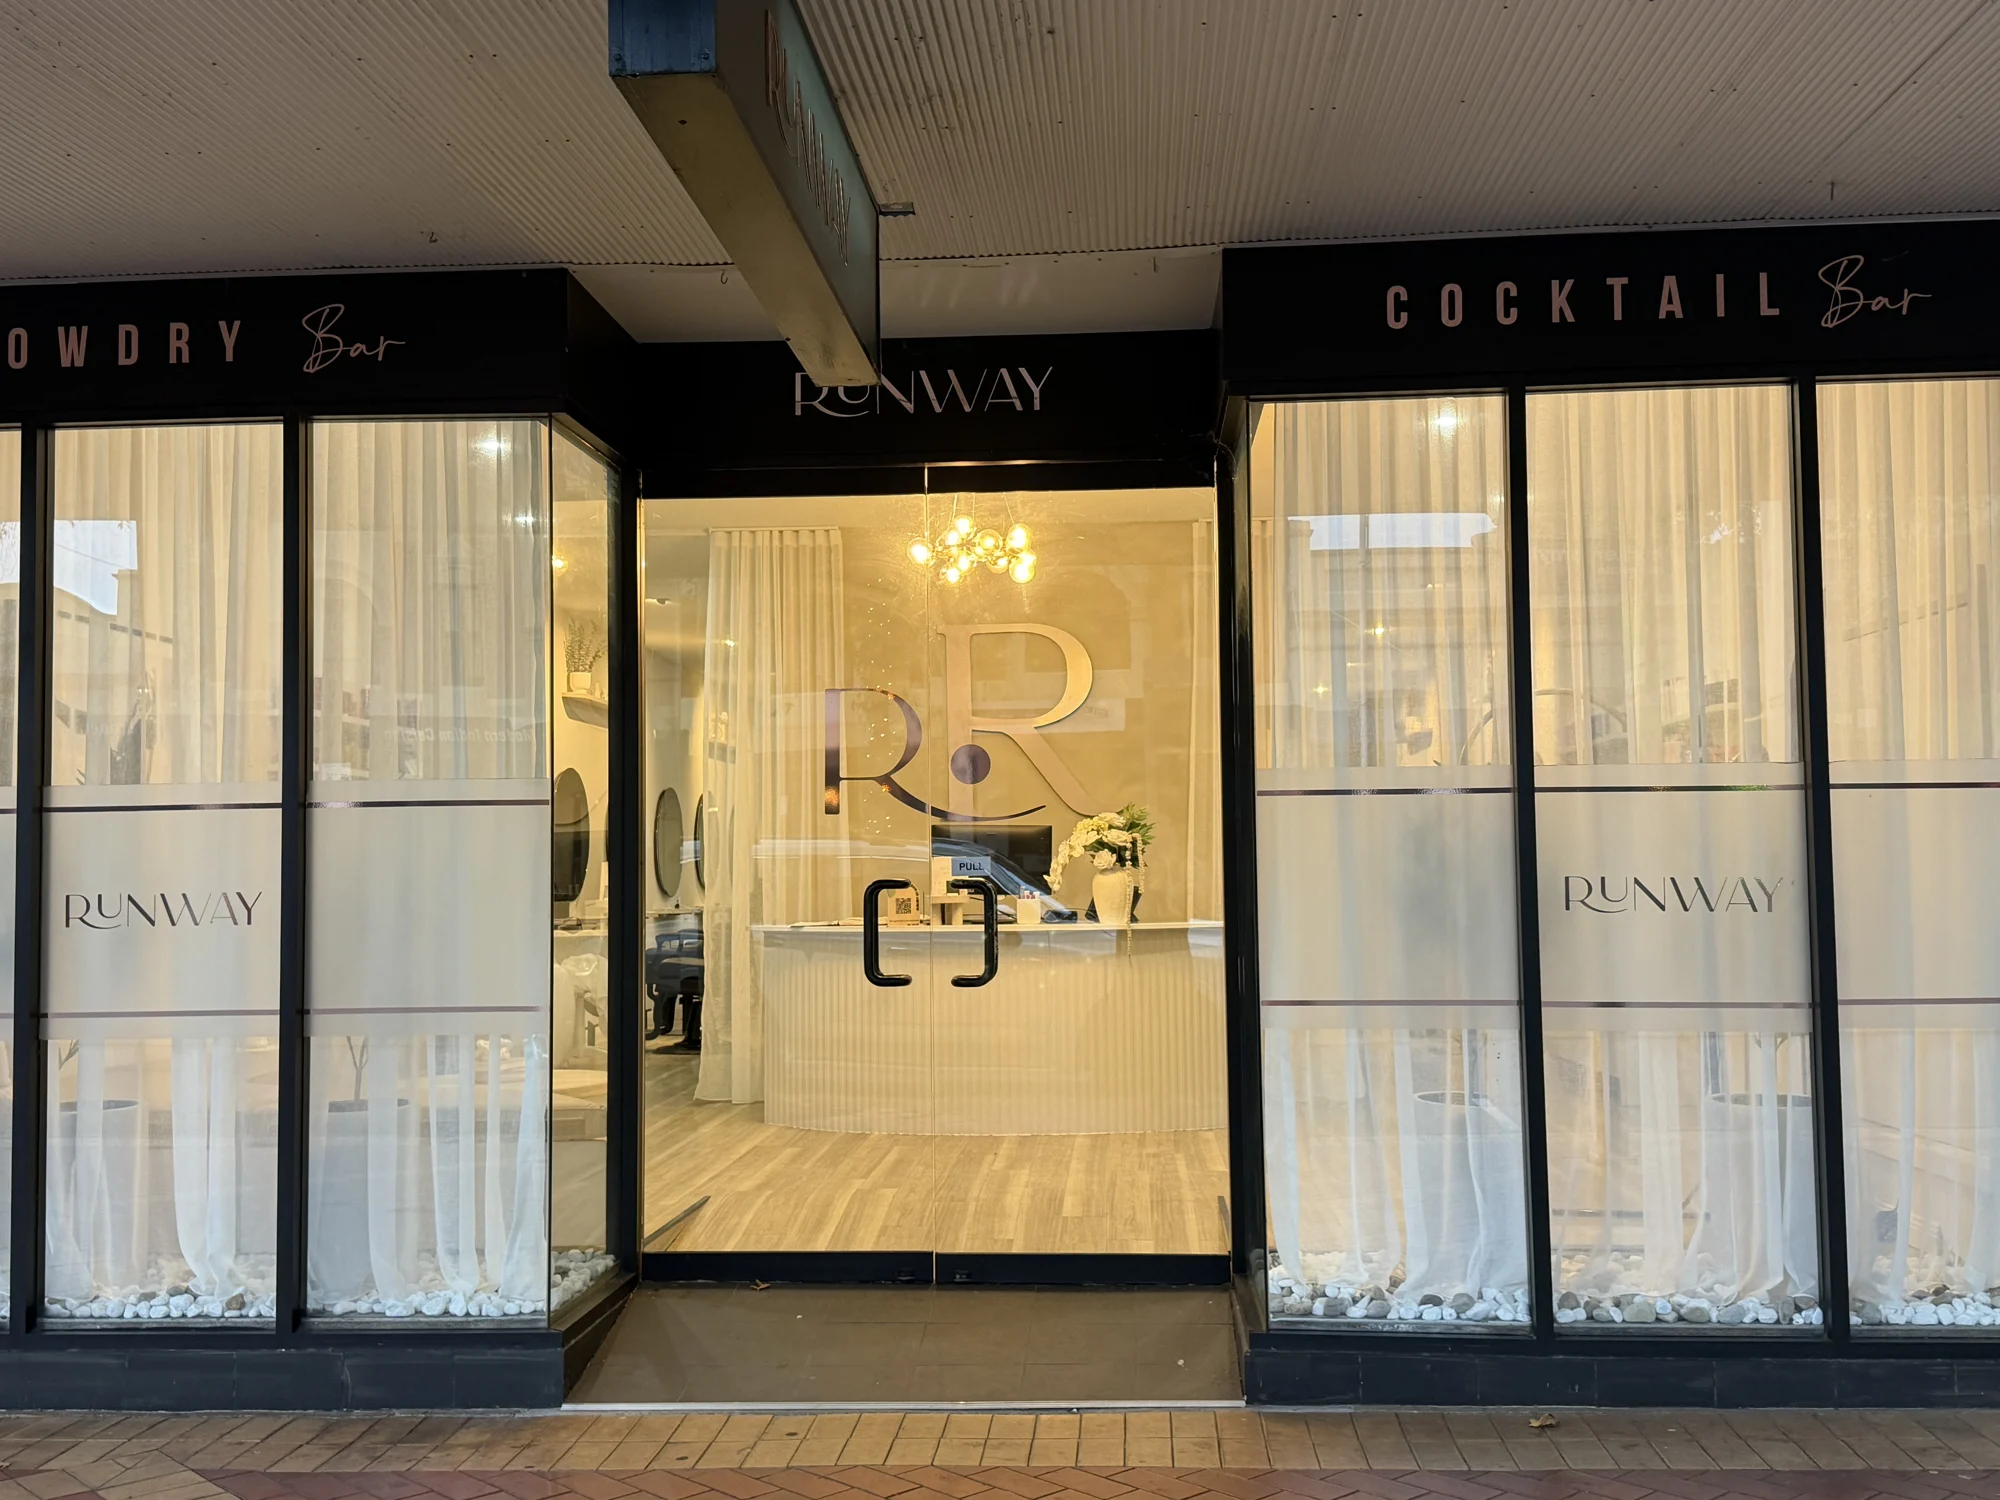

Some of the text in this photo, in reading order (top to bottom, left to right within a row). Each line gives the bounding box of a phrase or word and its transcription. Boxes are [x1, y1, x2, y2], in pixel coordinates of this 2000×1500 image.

[1386, 254, 1933, 329] COCKTAIL Bar
[7, 303, 406, 373] OWDRY Bar
[959, 862, 984, 871] PULL
[64, 891, 262, 930] RUNWAY
[1564, 875, 1783, 914] RUNWAY
